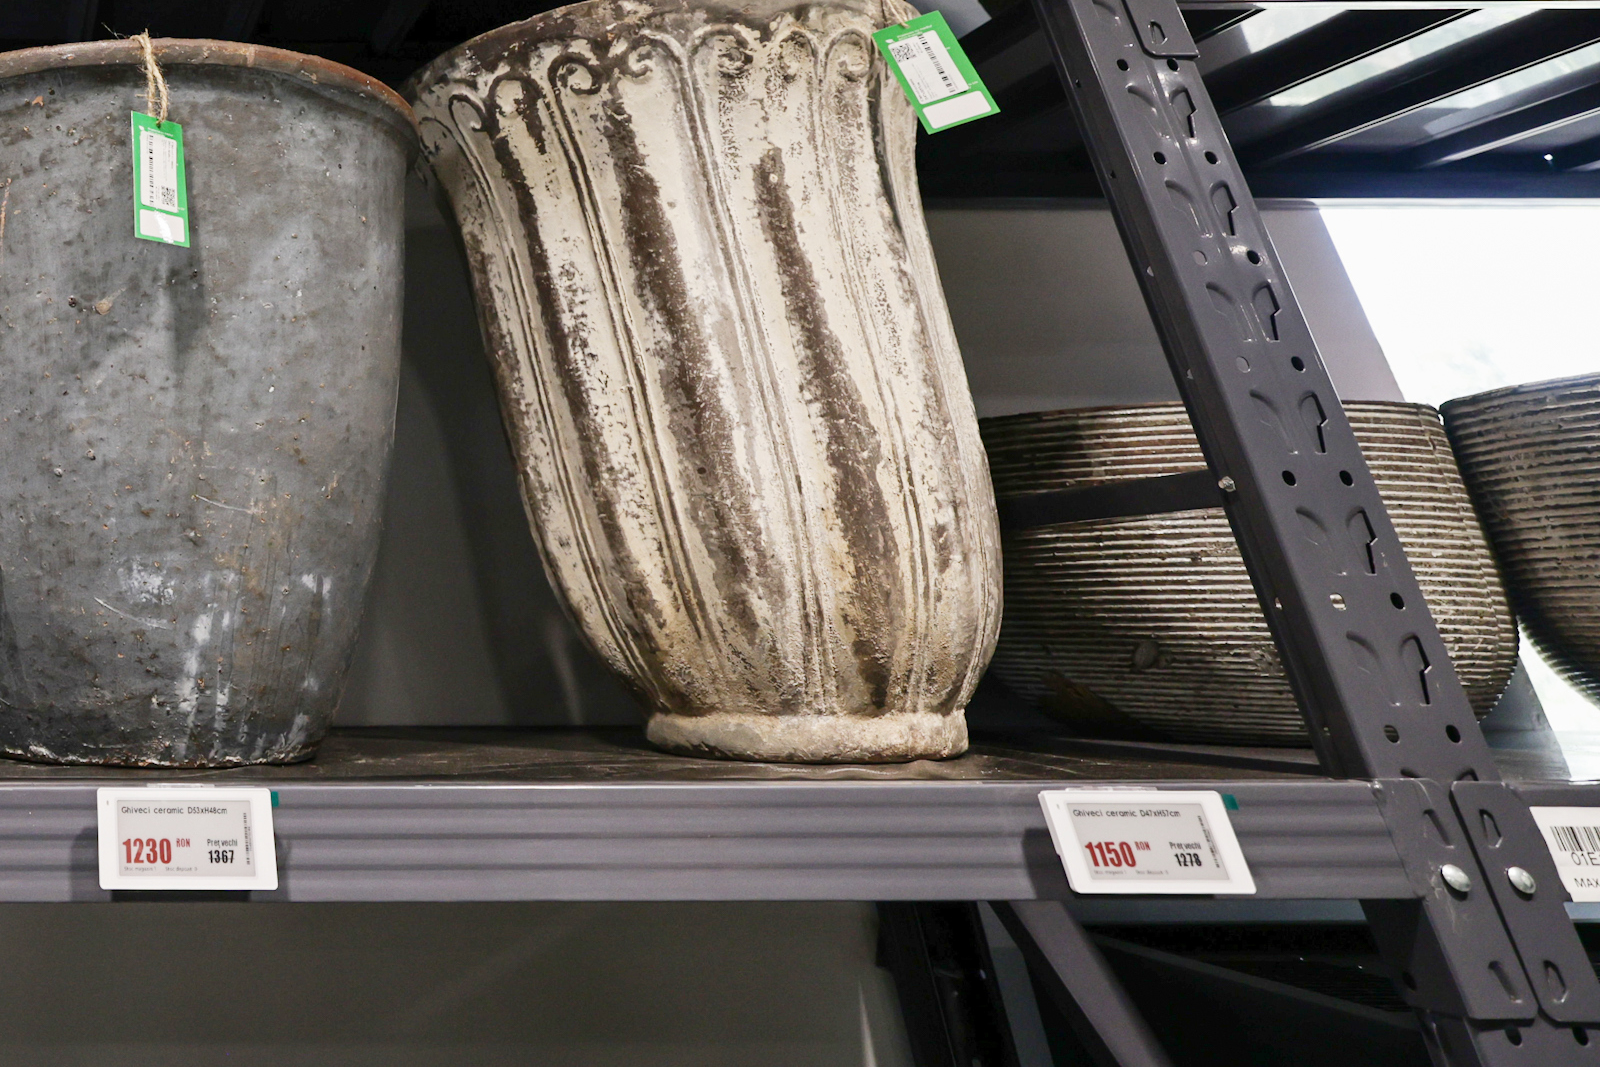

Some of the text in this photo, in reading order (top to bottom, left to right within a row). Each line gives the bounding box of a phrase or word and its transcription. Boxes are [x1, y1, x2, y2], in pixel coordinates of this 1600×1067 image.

[121, 806, 228, 815] Ghiveci ceramic D53xH48cm
[1072, 809, 1182, 818] Ghiveci ceramic D47xH57cm
[221, 838, 238, 847] vechi
[122, 837, 191, 864] 1230 RON
[208, 850, 234, 864] 1367
[1084, 841, 1151, 868] 1150 RON
[1174, 853, 1202, 867] 1278
[1574, 877, 1600, 889] MAX
